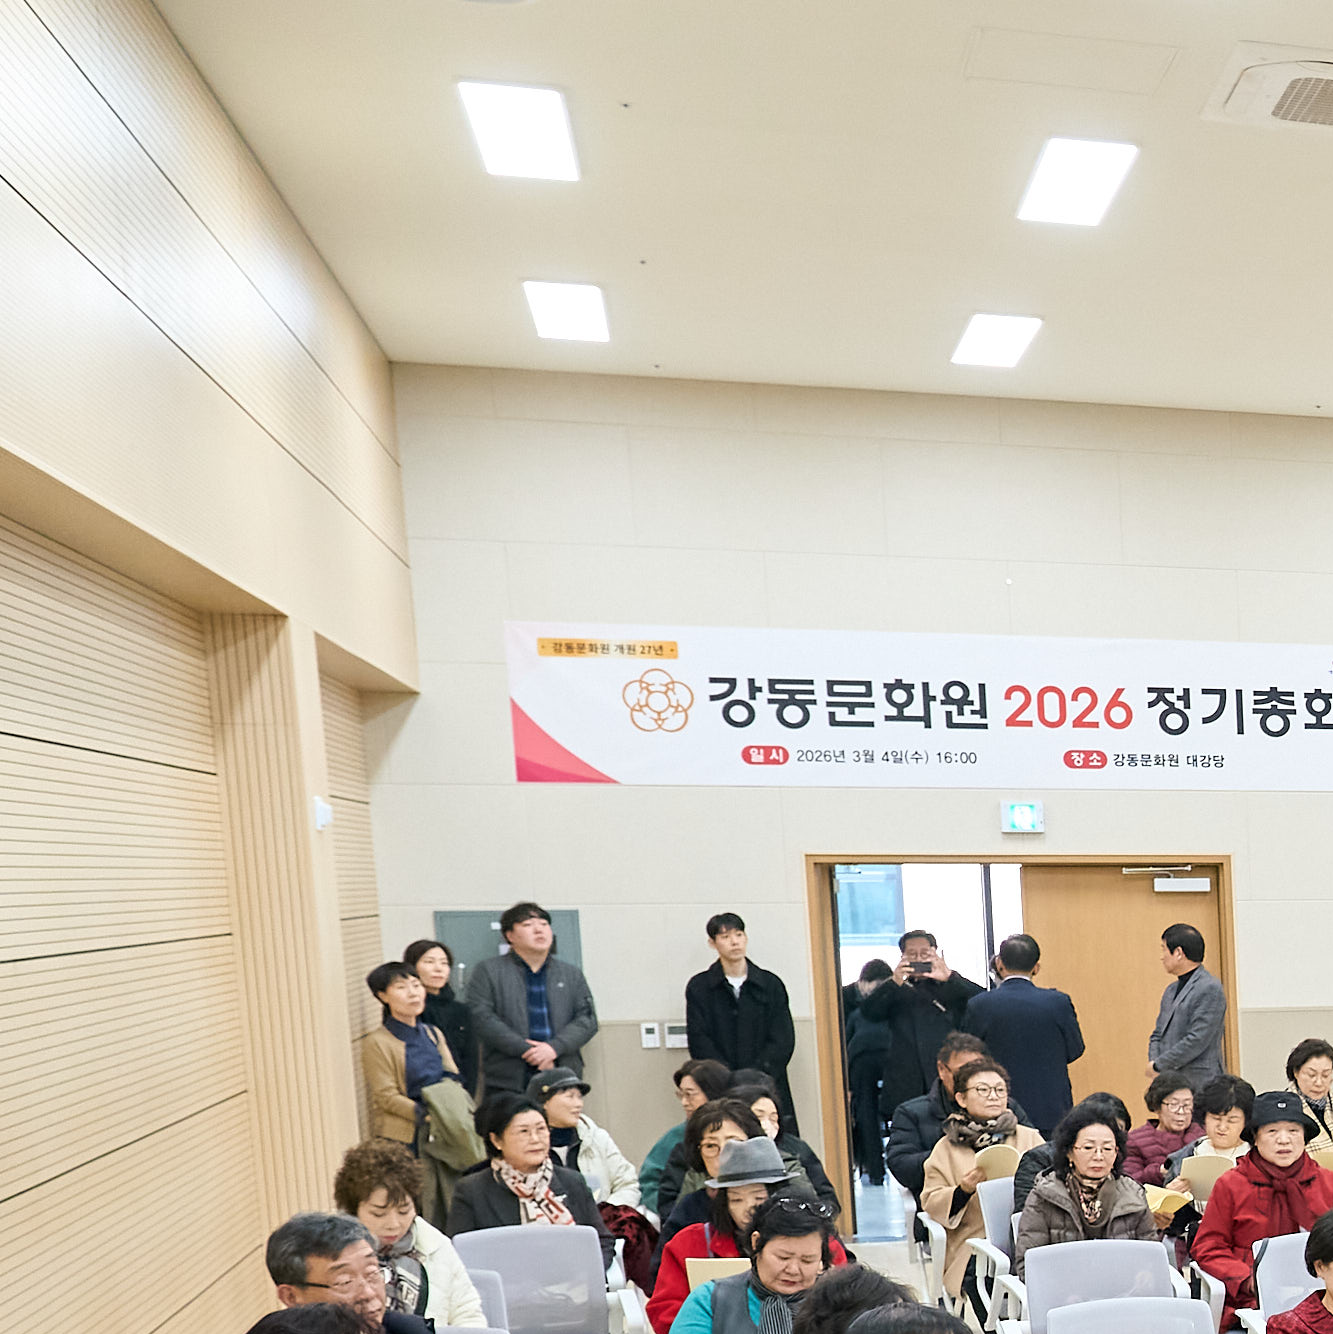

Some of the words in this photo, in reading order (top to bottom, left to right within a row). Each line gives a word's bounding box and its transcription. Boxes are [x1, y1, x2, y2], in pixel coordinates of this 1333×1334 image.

[552, 642, 610, 655] 강동문화원
[614, 643, 637, 655] 개원
[640, 645, 664, 656] 27년
[708, 675, 990, 731] 강동문화원
[1003, 684, 1134, 730] 2026
[796, 749, 846, 763] 2026년
[852, 749, 875, 764] 3월
[881, 750, 929, 765] 4일(수)
[936, 751, 978, 764] 16:00
[1113, 753, 1180, 768] 강동문화원
[1186, 754, 1225, 768] 대강당
